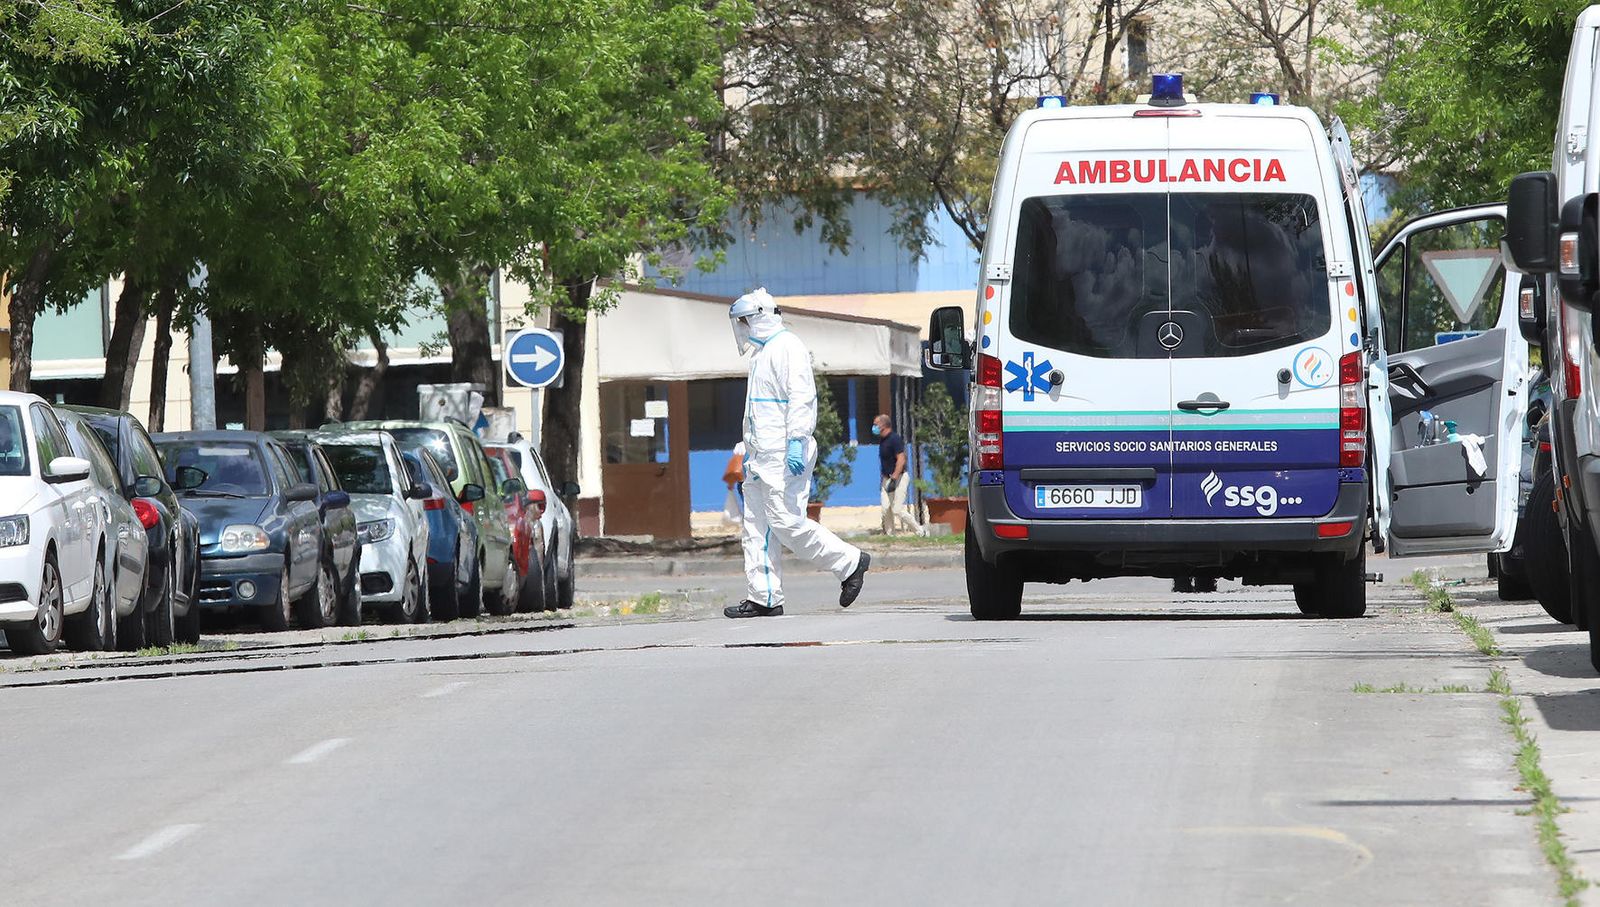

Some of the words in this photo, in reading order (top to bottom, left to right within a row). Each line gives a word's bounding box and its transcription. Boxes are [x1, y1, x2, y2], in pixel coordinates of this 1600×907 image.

[1053, 158, 1287, 185] AMBULANCIA
[1055, 441, 1111, 453] SERVICIOS
[1113, 441, 1147, 452] SOCIO
[1149, 441, 1212, 452] SANITARIOS
[1214, 440, 1278, 452] GENERALES
[1050, 487, 1095, 505] 6660
[1104, 487, 1137, 504] JJD
